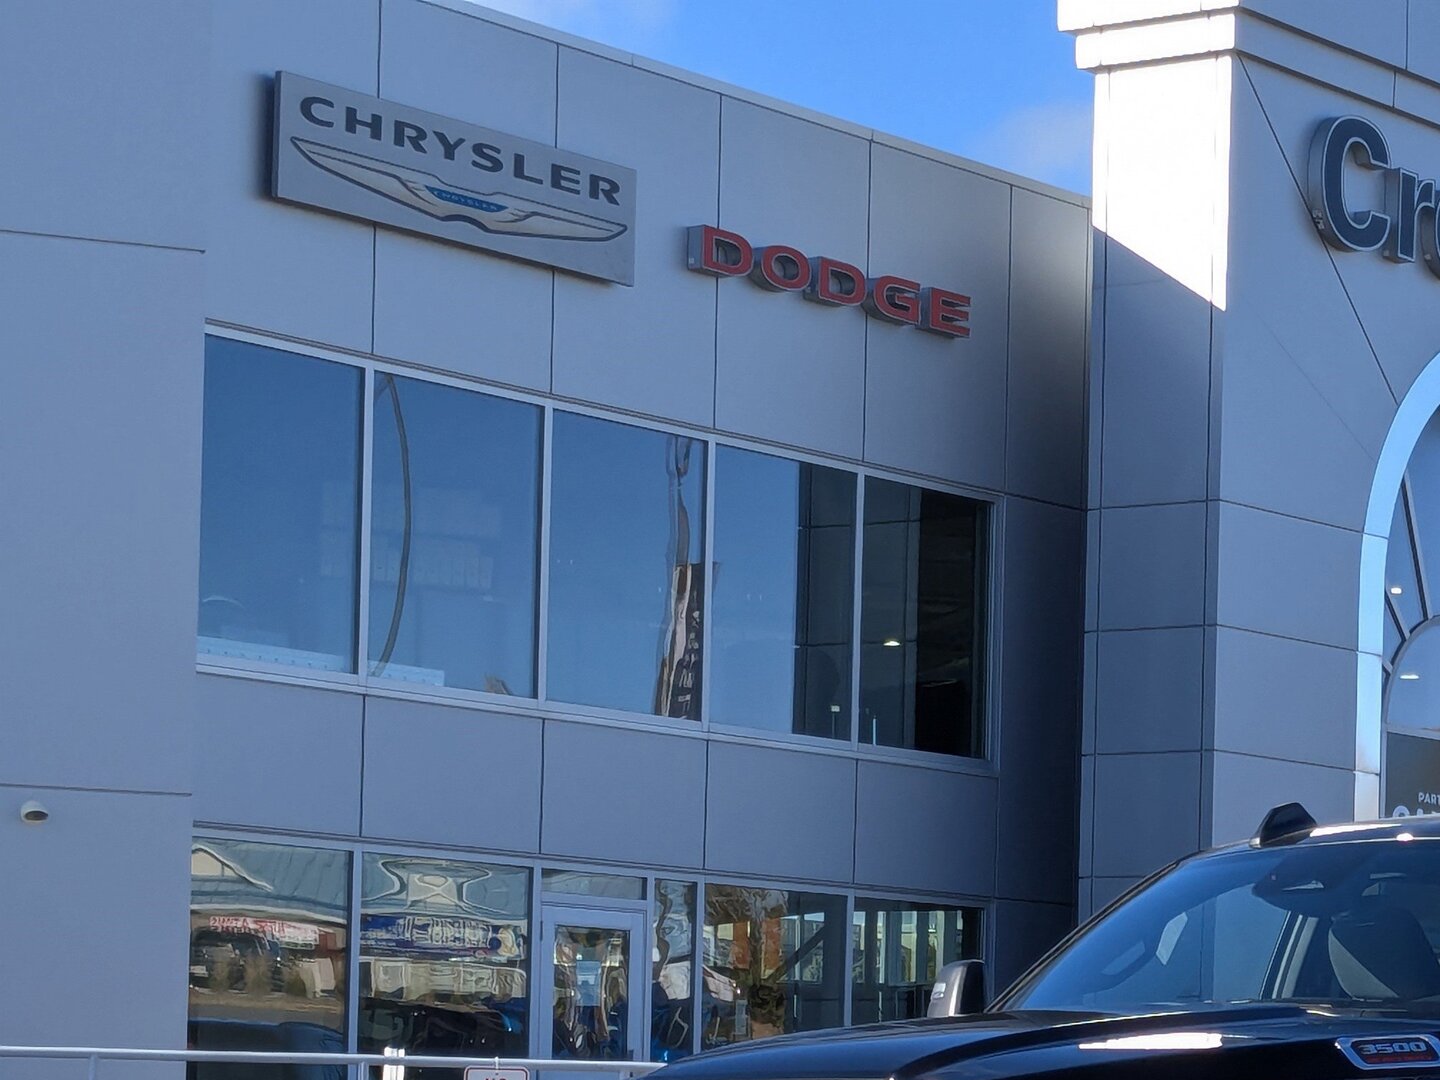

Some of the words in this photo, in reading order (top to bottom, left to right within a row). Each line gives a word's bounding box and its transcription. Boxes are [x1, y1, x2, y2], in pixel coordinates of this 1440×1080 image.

[298, 95, 622, 207] CHRYSLER
[694, 224, 972, 339] DODGE
[1359, 1041, 1427, 1055] 3500
